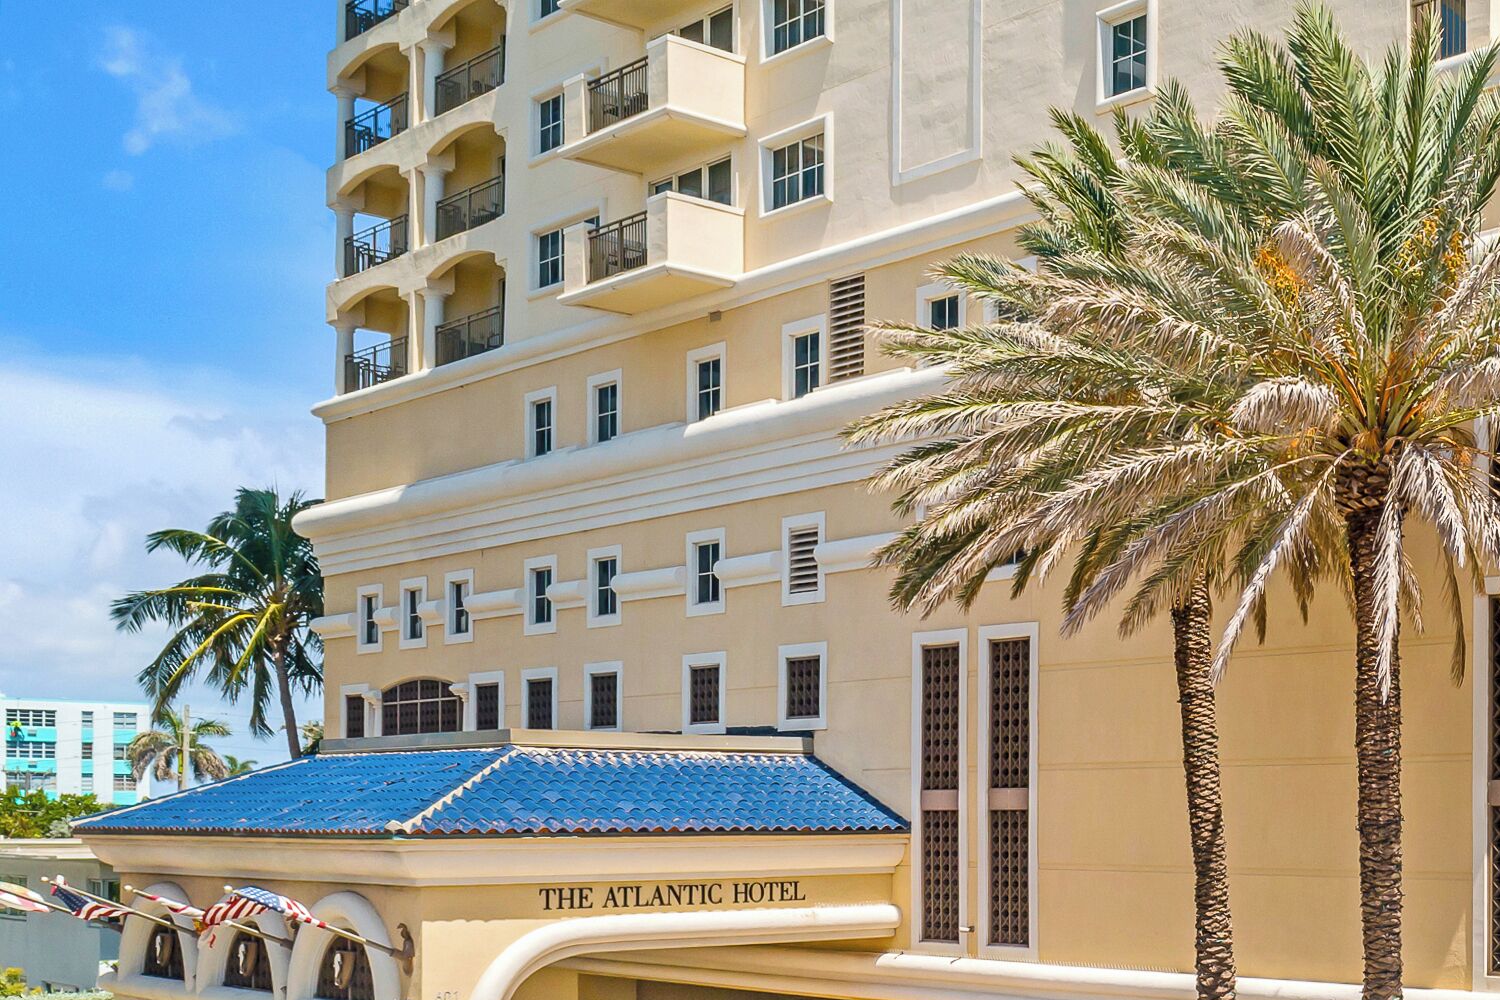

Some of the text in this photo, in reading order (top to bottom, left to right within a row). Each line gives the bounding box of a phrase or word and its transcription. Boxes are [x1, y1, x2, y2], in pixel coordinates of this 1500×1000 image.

[538, 881, 806, 910] THE ATLANTIC HOTEL
